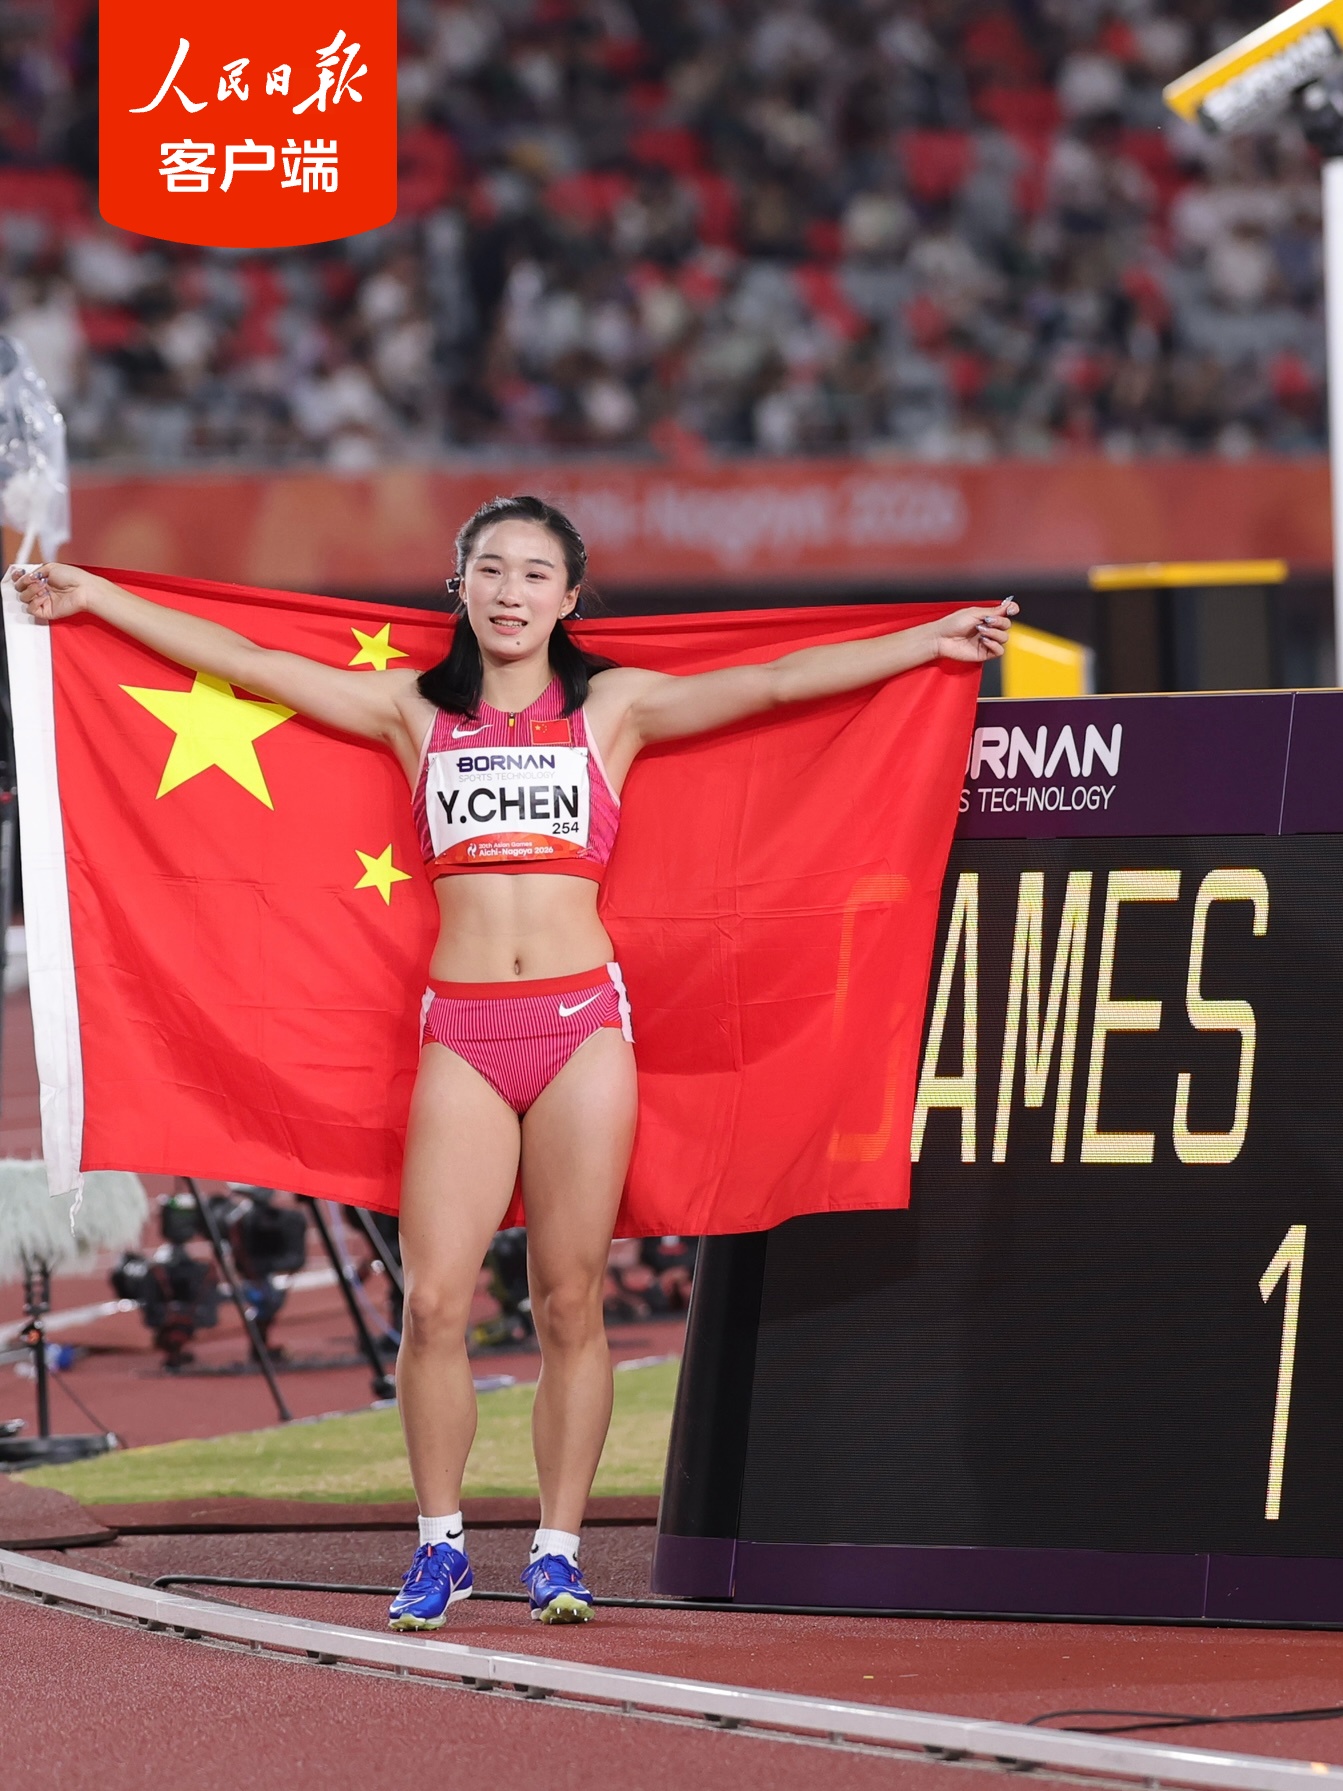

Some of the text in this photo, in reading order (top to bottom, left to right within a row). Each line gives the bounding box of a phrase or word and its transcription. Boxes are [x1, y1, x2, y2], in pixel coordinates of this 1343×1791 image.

[456, 754, 556, 773] BORNAN
[458, 772, 556, 783] SPORTS TECHNOLOGY
[437, 785, 579, 824] Y.CHEN
[977, 785, 1116, 813] TECHNOLOGY
[552, 821, 580, 835] 254
[479, 846, 554, 857] Aichi-Nagoya 2026
